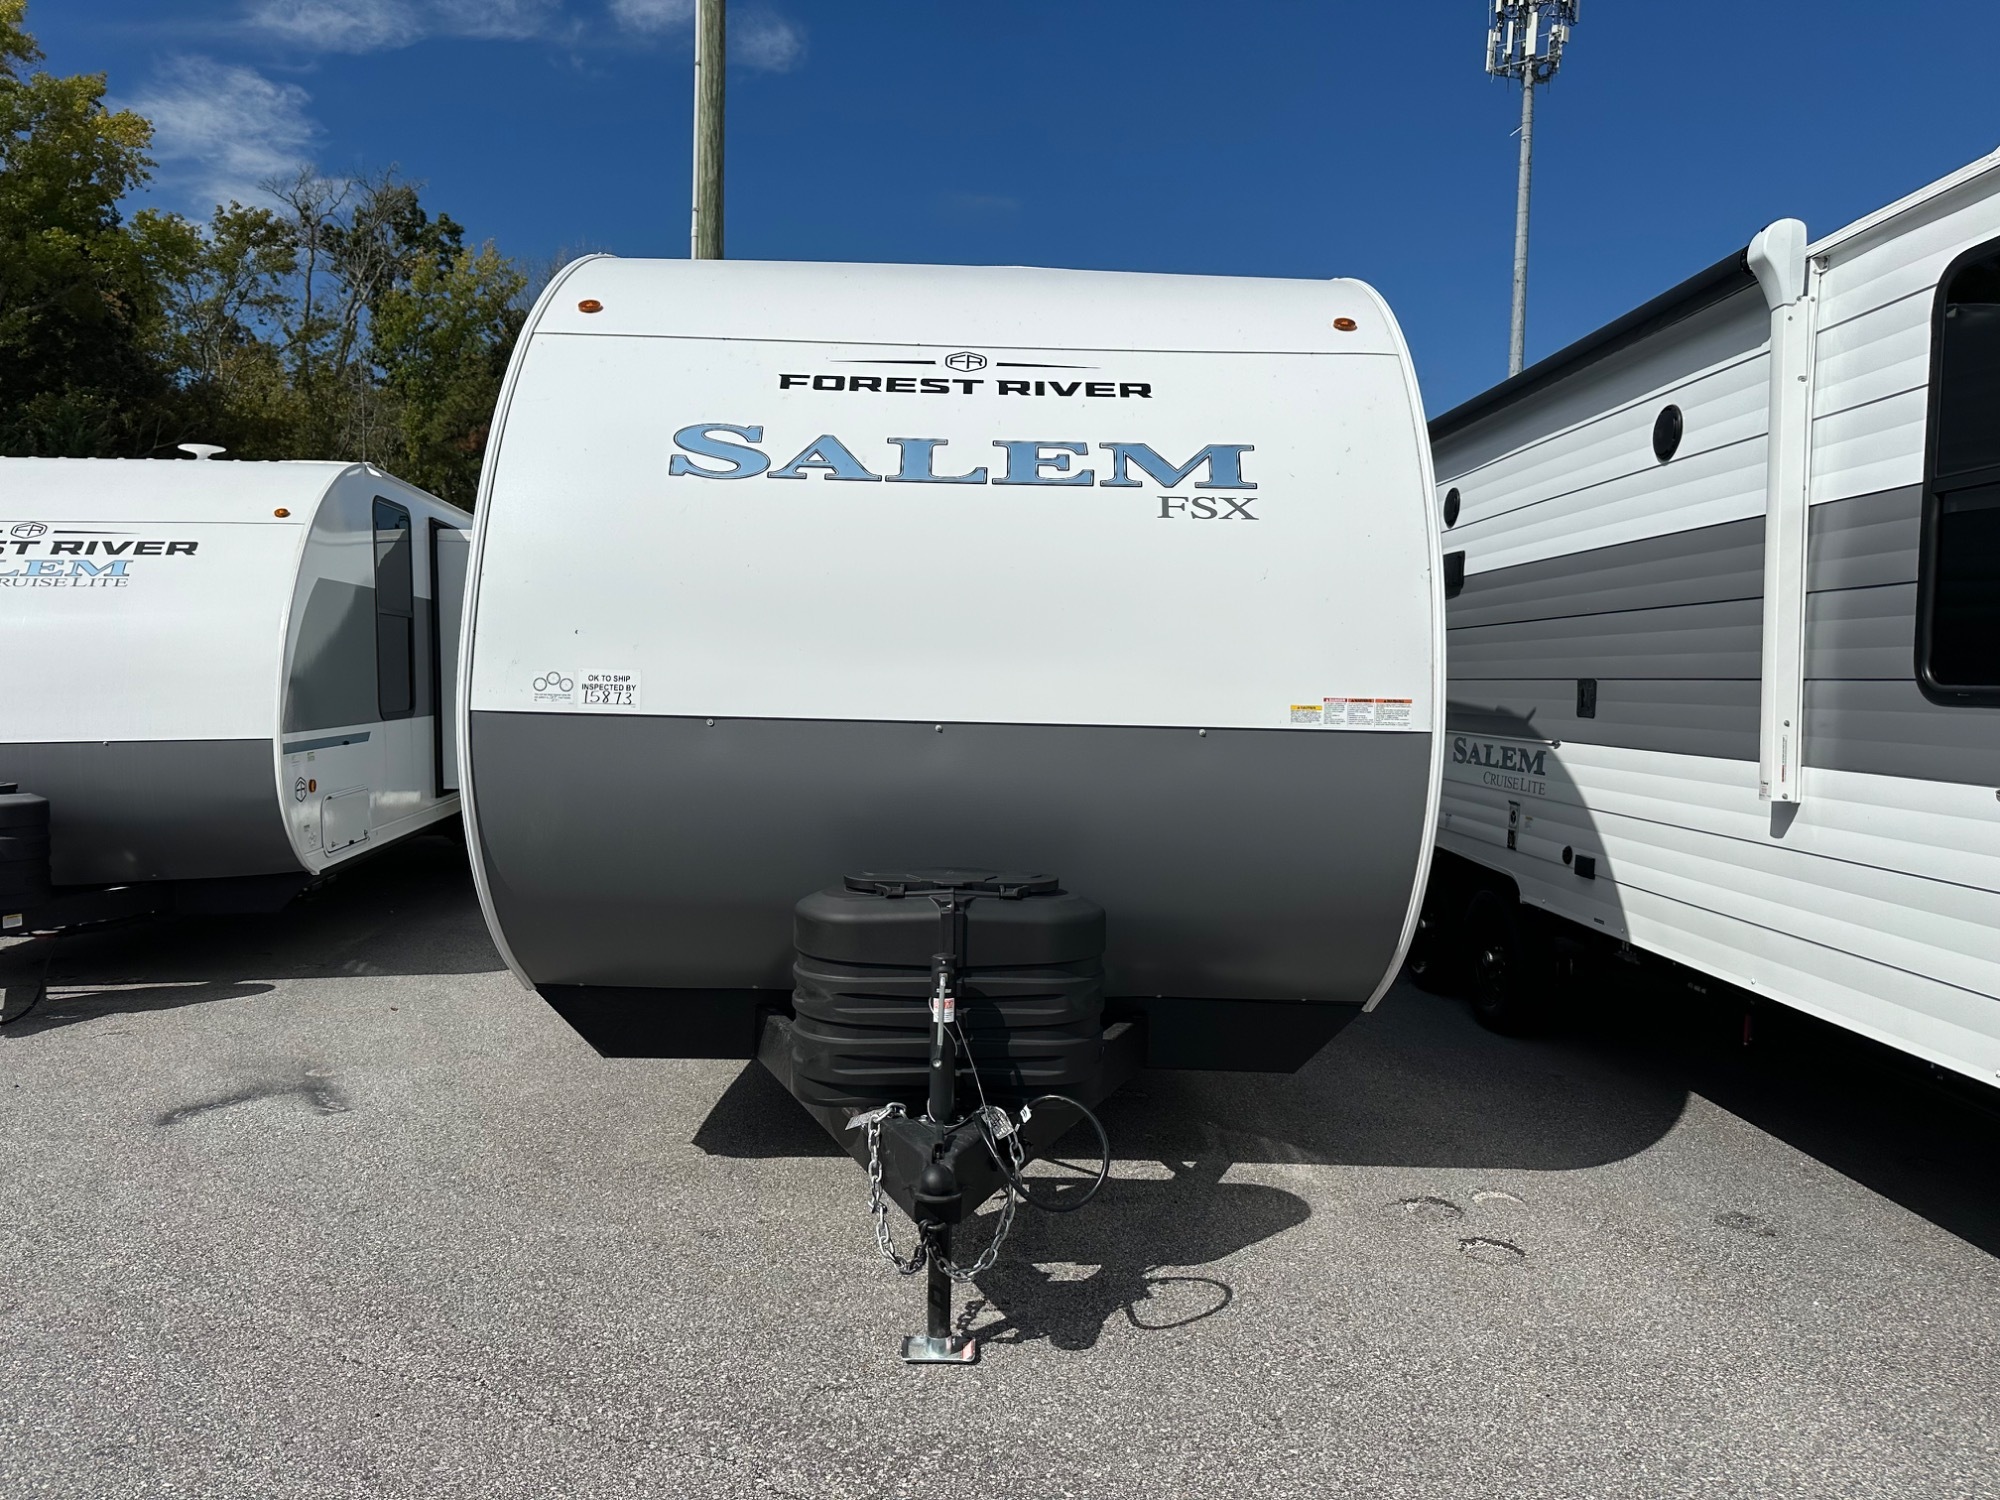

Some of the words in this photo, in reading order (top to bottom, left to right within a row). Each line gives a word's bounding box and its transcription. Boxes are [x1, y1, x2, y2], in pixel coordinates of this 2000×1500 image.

[779, 373, 984, 395] FOREST
[996, 380, 1152, 398] RIVER
[668, 423, 1258, 489] SALEM
[1157, 496, 1259, 520] FSX
[50, 541, 198, 556] RIVER
[582, 683, 625, 691] INSPECTED
[588, 674, 599, 682] OK
[584, 690, 632, 704] 15873
[1453, 737, 1546, 776] SALEM
